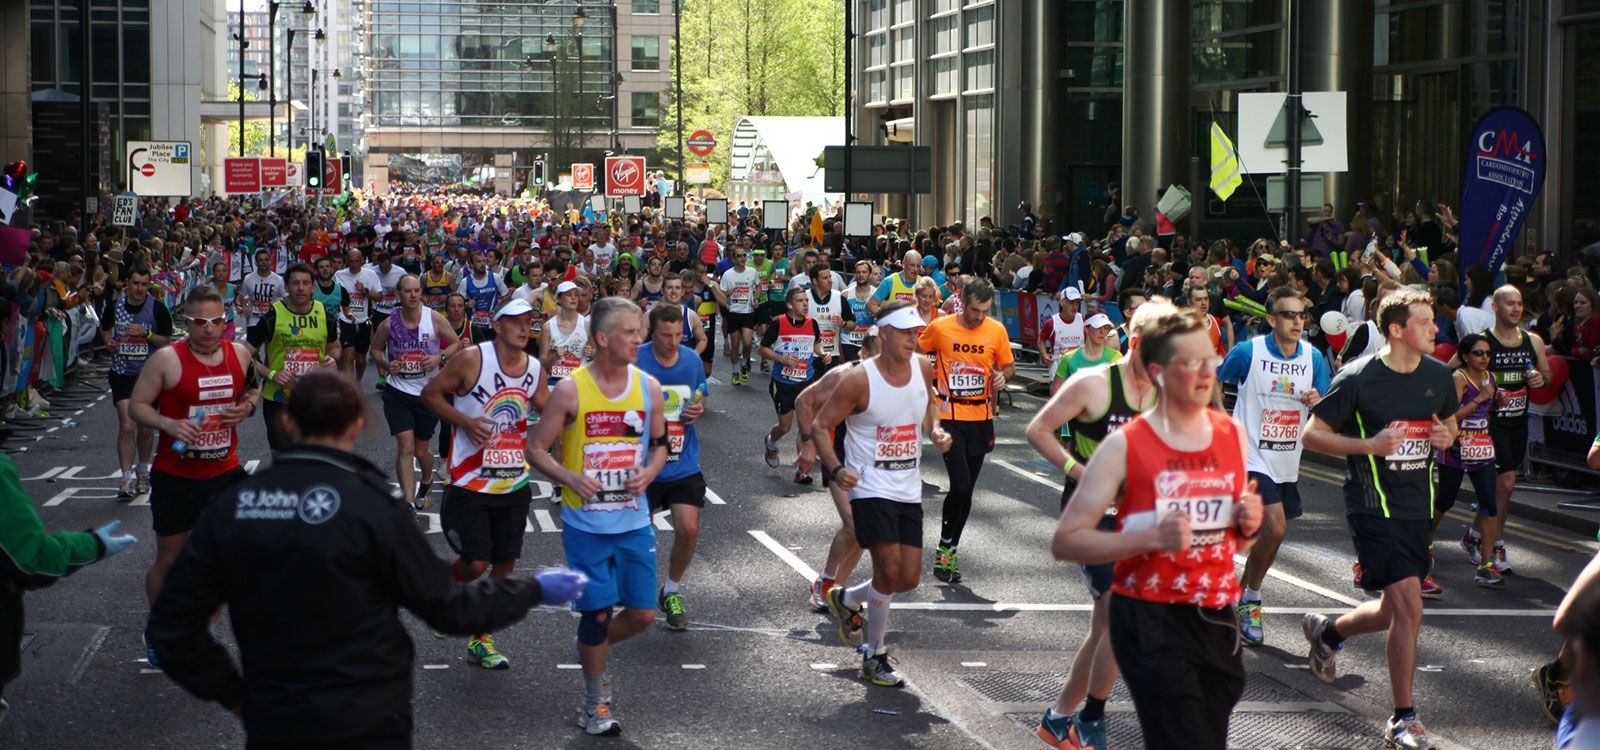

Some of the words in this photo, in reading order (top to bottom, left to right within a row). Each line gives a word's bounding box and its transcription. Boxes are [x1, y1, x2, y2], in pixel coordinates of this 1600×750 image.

[1477, 129, 1536, 165] CMA
[614, 162, 637, 183] Virgin
[117, 198, 133, 206] ED'S
[116, 207, 133, 215] FAN
[289, 316, 318, 329] JON
[120, 344, 148, 354] 13273
[393, 340, 428, 350] MICHAEL
[953, 343, 985, 354] ROSS
[1260, 359, 1308, 377] TERRY
[951, 375, 984, 387] 15156
[1503, 372, 1524, 382] NEIL
[586, 412, 622, 424] children
[1552, 414, 1588, 437] adidas
[586, 427, 610, 437] cancer
[1262, 426, 1299, 440] 53766
[877, 443, 917, 458] 35645
[1272, 442, 1296, 451] #boost
[1462, 446, 1493, 458] 50247
[484, 450, 524, 464] 49619
[1166, 453, 1219, 472] MIKE
[1401, 461, 1427, 471] #boost
[237, 491, 255, 508] St
[256, 490, 299, 508] John
[235, 509, 296, 520] Ambulance
